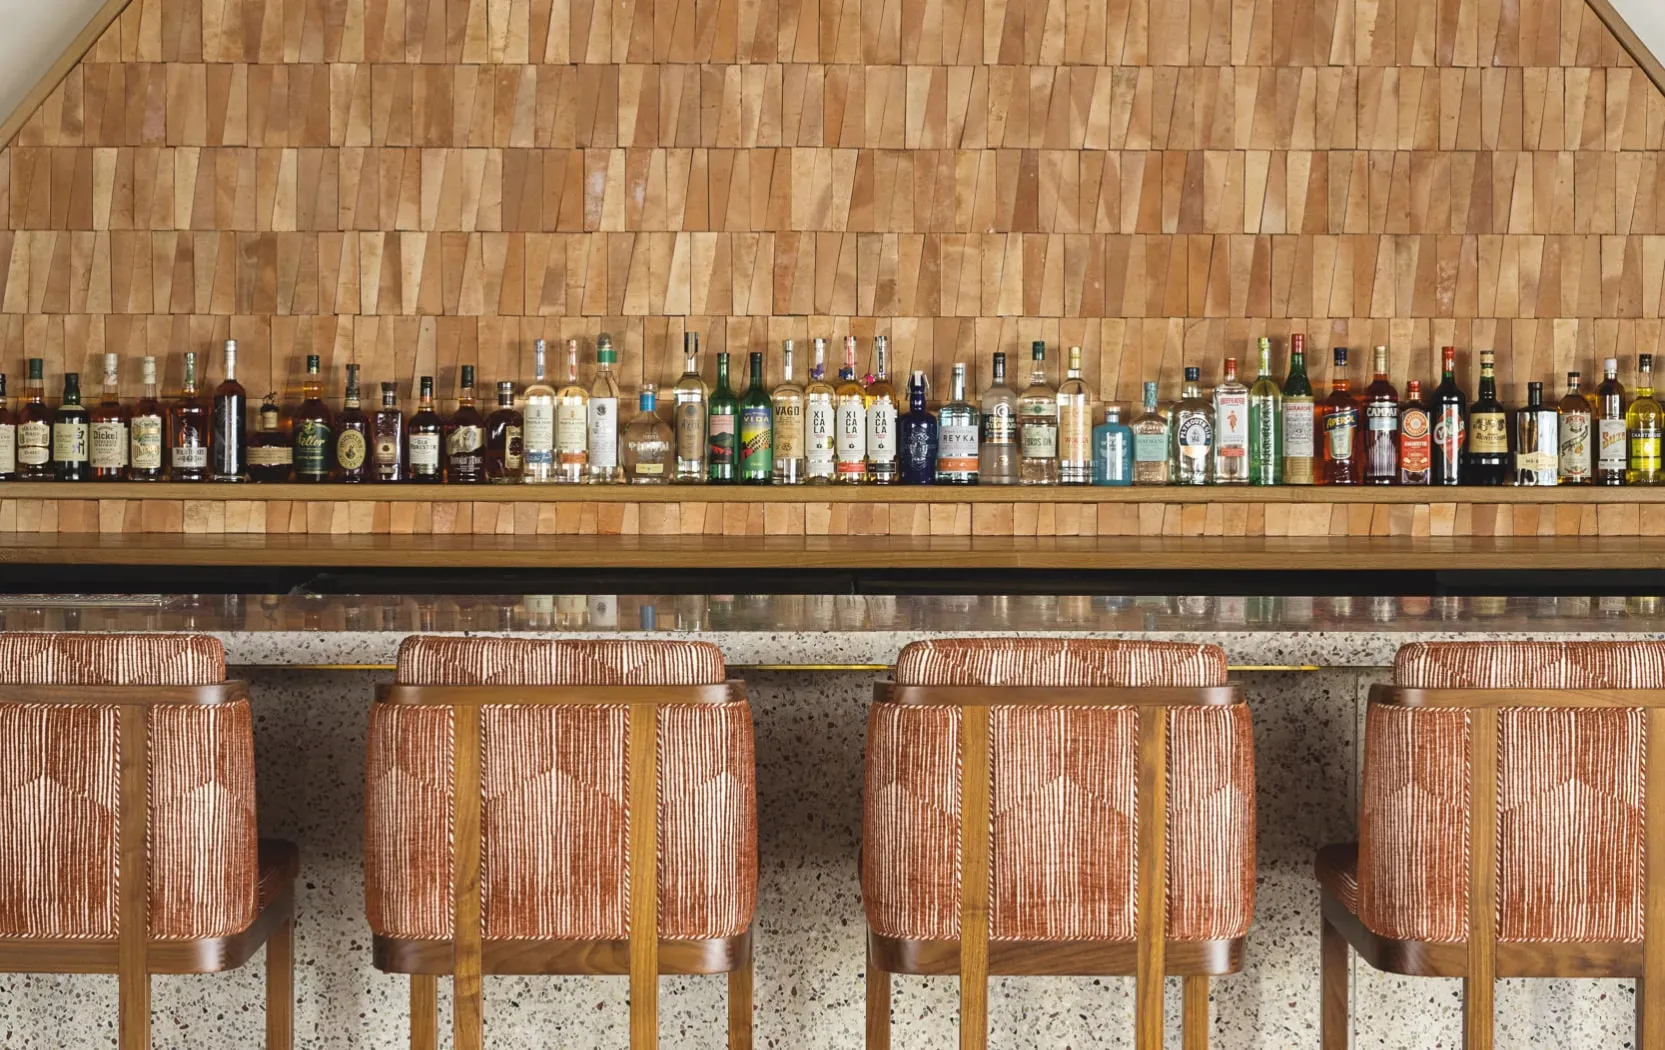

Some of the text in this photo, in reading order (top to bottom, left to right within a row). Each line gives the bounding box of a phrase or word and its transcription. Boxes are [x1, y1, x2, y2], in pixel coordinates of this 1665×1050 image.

[775, 406, 800, 416] VAGO
[1366, 408, 1397, 417] CAMPAR
[93, 431, 118, 440] Dickel
[943, 434, 975, 442] REYKA
